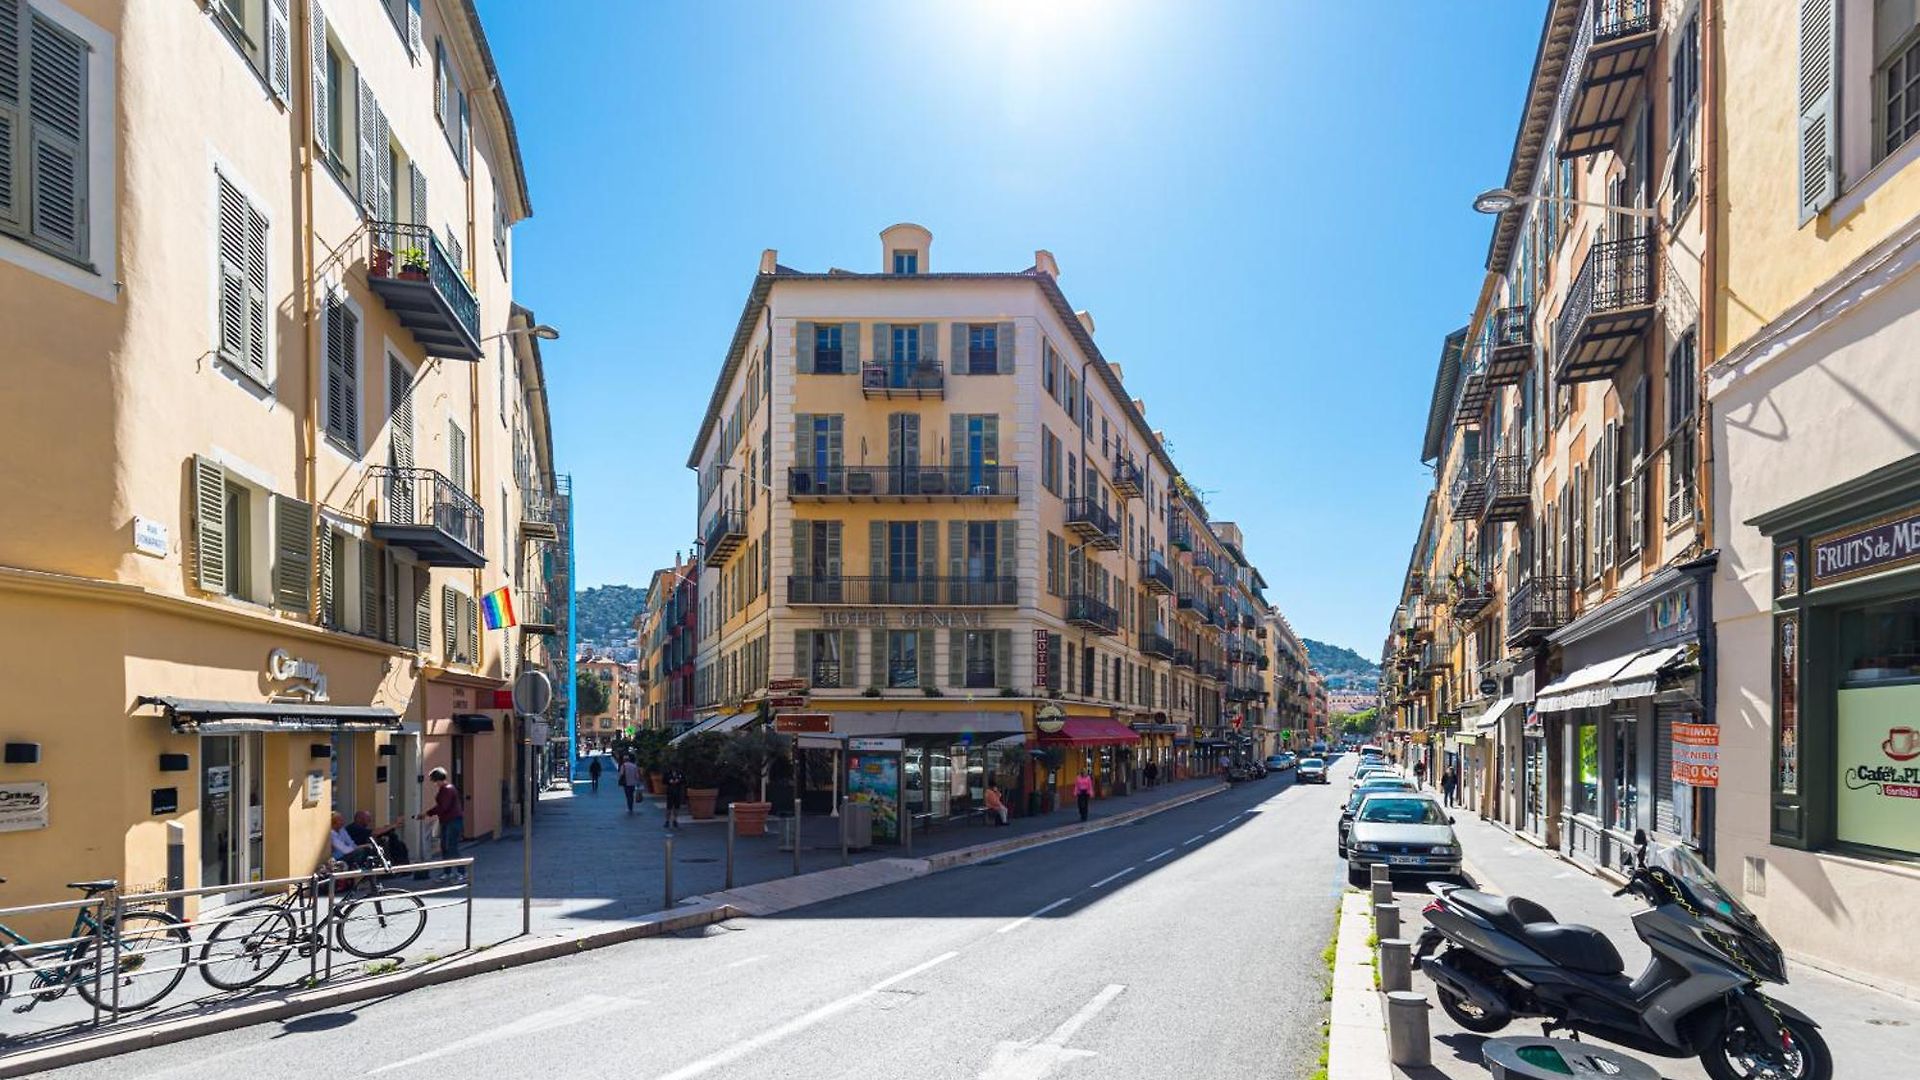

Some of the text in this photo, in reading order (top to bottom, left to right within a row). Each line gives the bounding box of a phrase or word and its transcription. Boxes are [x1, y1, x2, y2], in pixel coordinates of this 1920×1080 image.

[1816, 521, 1920, 576] FRUITS de ME
[821, 611, 886, 627] HOTEL
[1037, 632, 1047, 687] HOTEL
